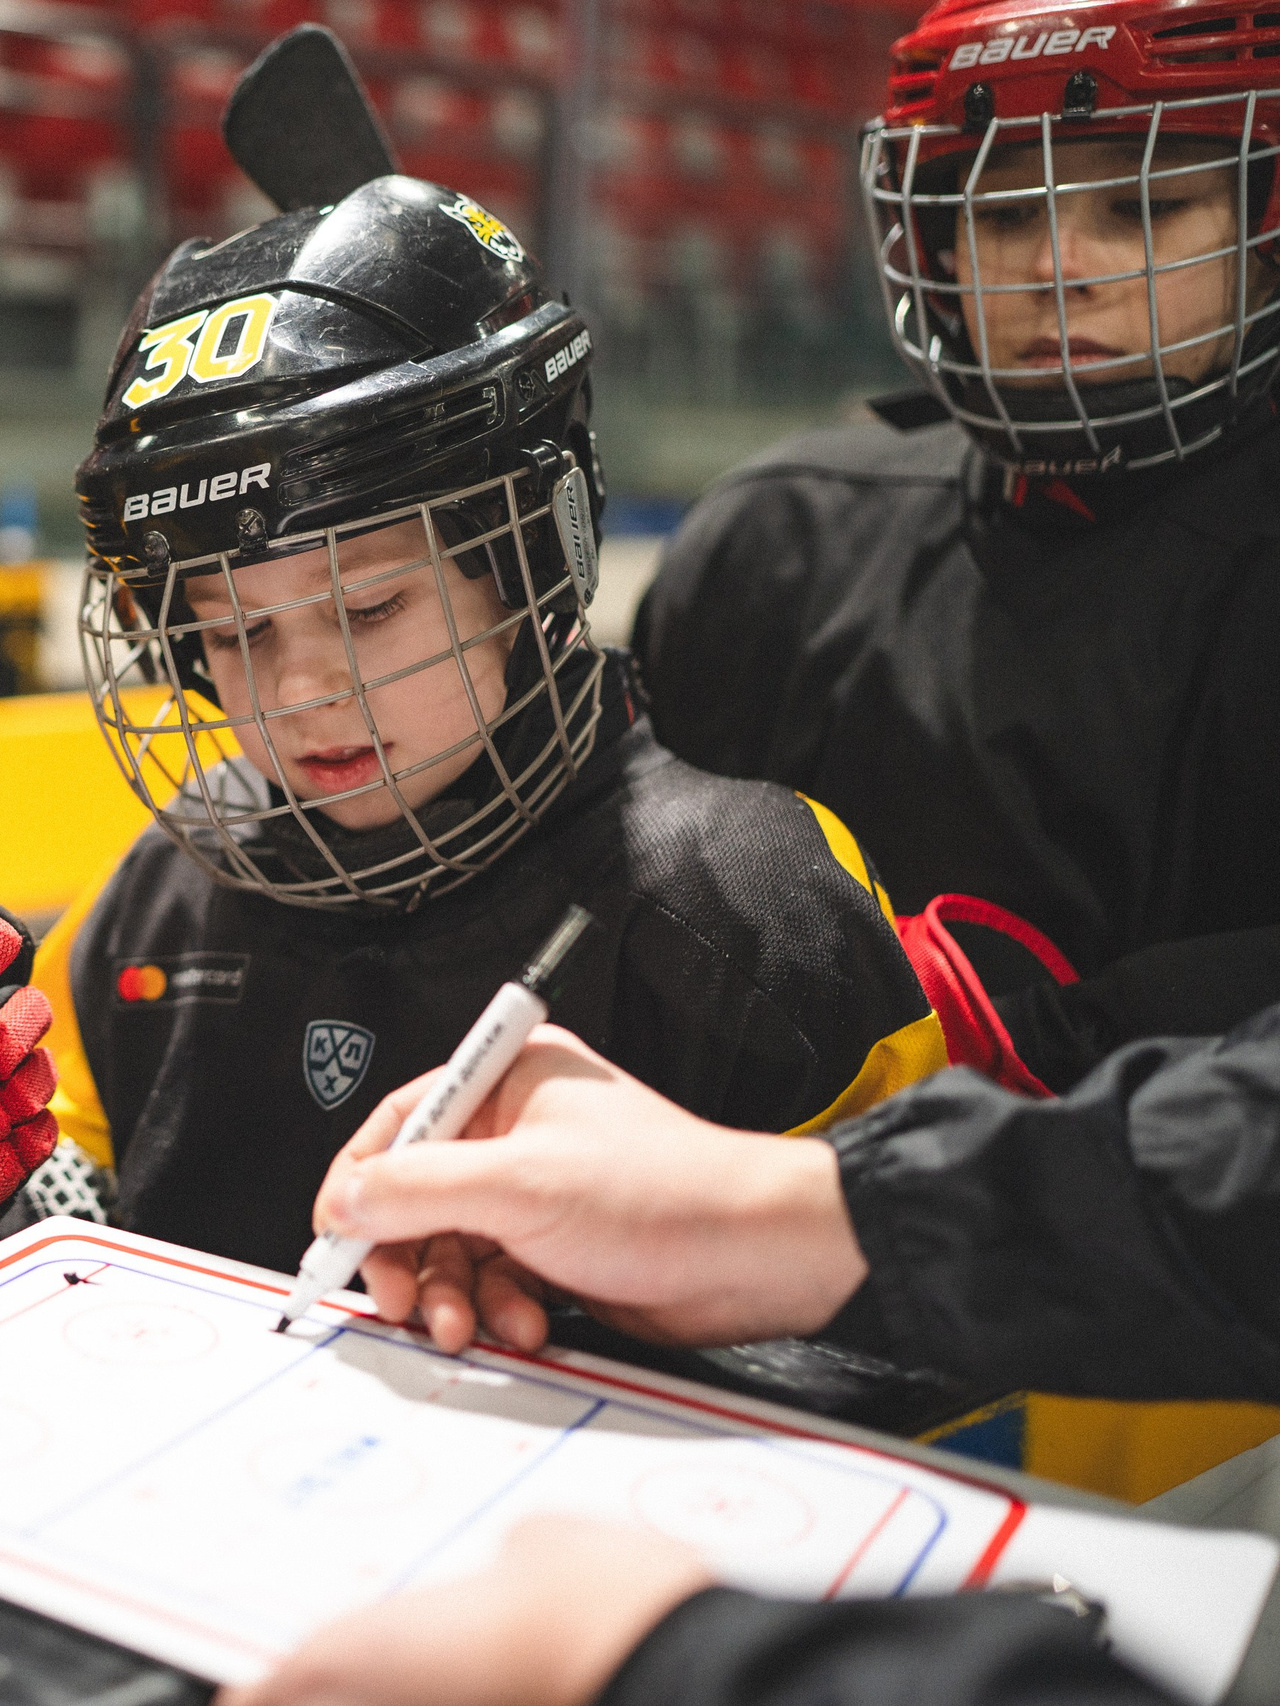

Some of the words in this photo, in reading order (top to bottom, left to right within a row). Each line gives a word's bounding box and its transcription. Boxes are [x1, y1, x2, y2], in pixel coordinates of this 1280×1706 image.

[948, 25, 1117, 71] BAUER
[122, 293, 278, 410] 30
[544, 328, 593, 384] BAUER
[123, 463, 271, 522] BAUER
